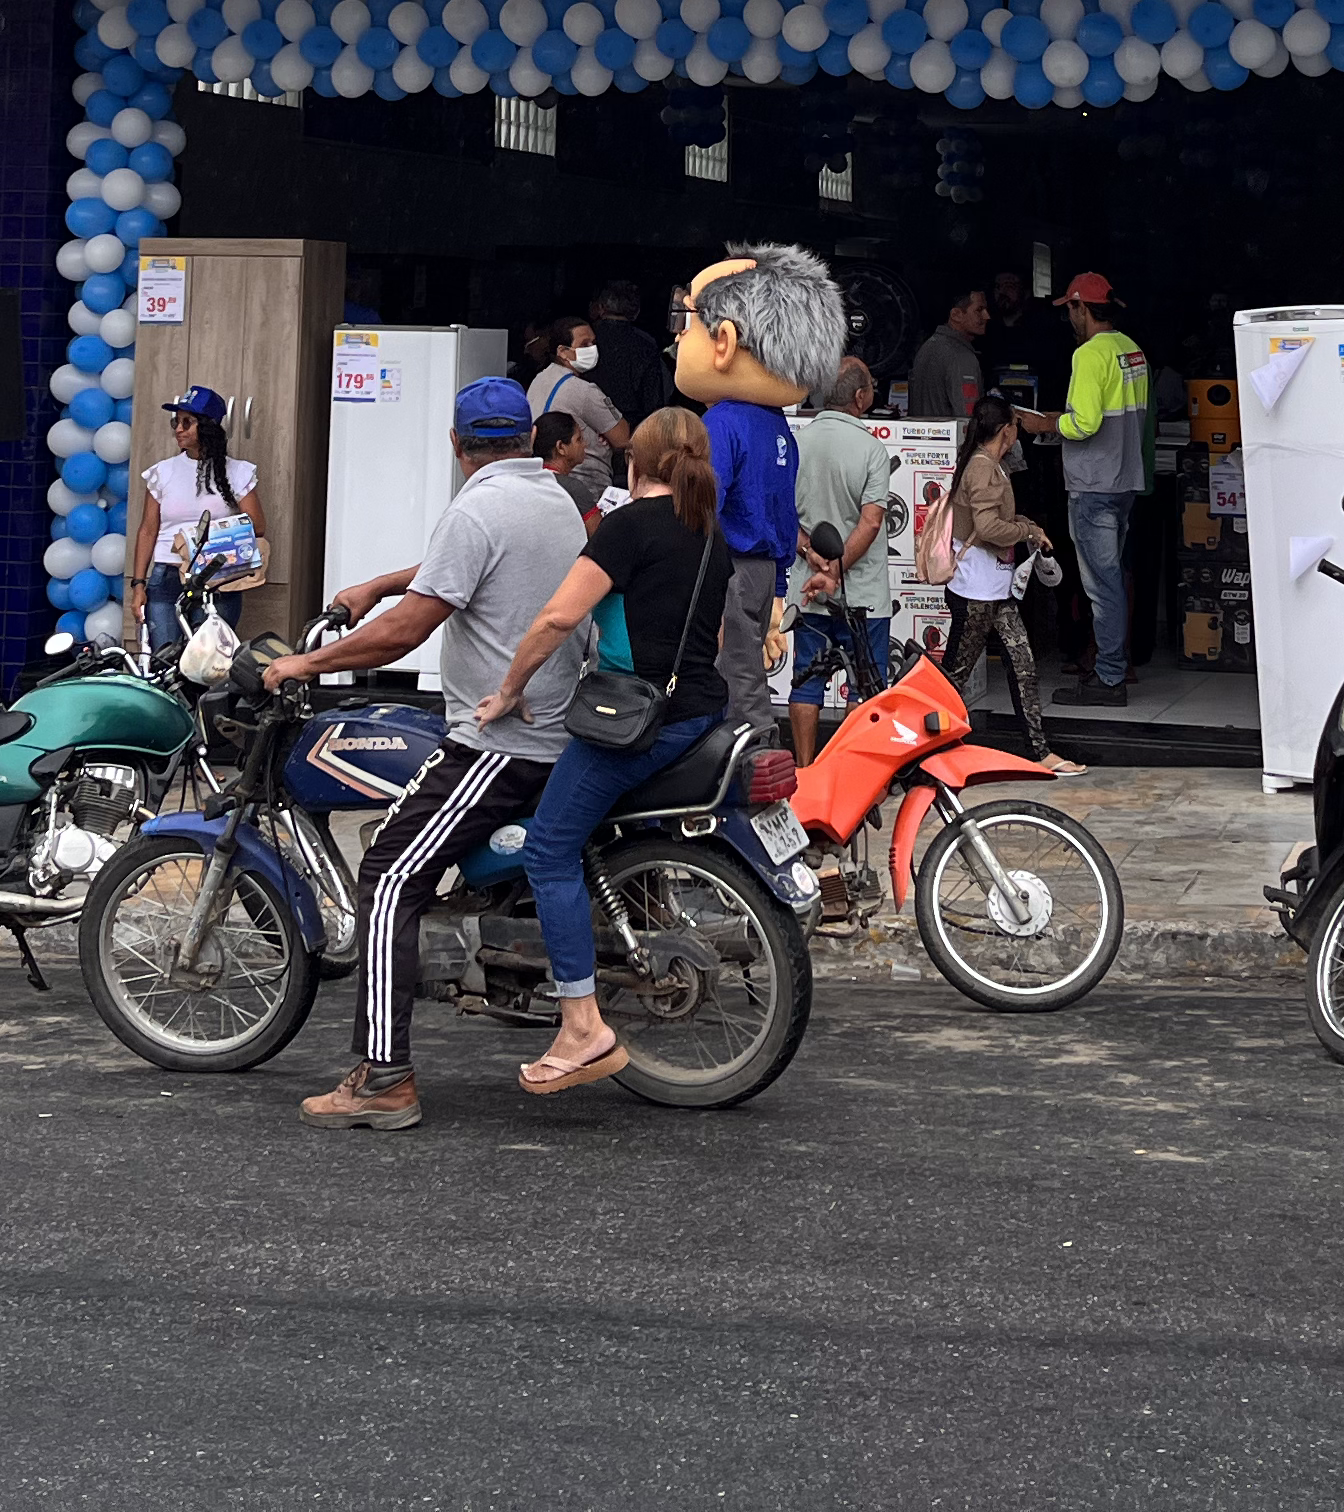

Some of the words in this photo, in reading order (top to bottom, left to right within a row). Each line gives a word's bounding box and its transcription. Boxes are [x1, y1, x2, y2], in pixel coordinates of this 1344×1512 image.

[902, 427, 926, 435] TURBO
[927, 428, 951, 436] FORCE
[927, 452, 949, 460] FORTE
[1221, 568, 1251, 587] Wap
[328, 736, 408, 751] HONDA
